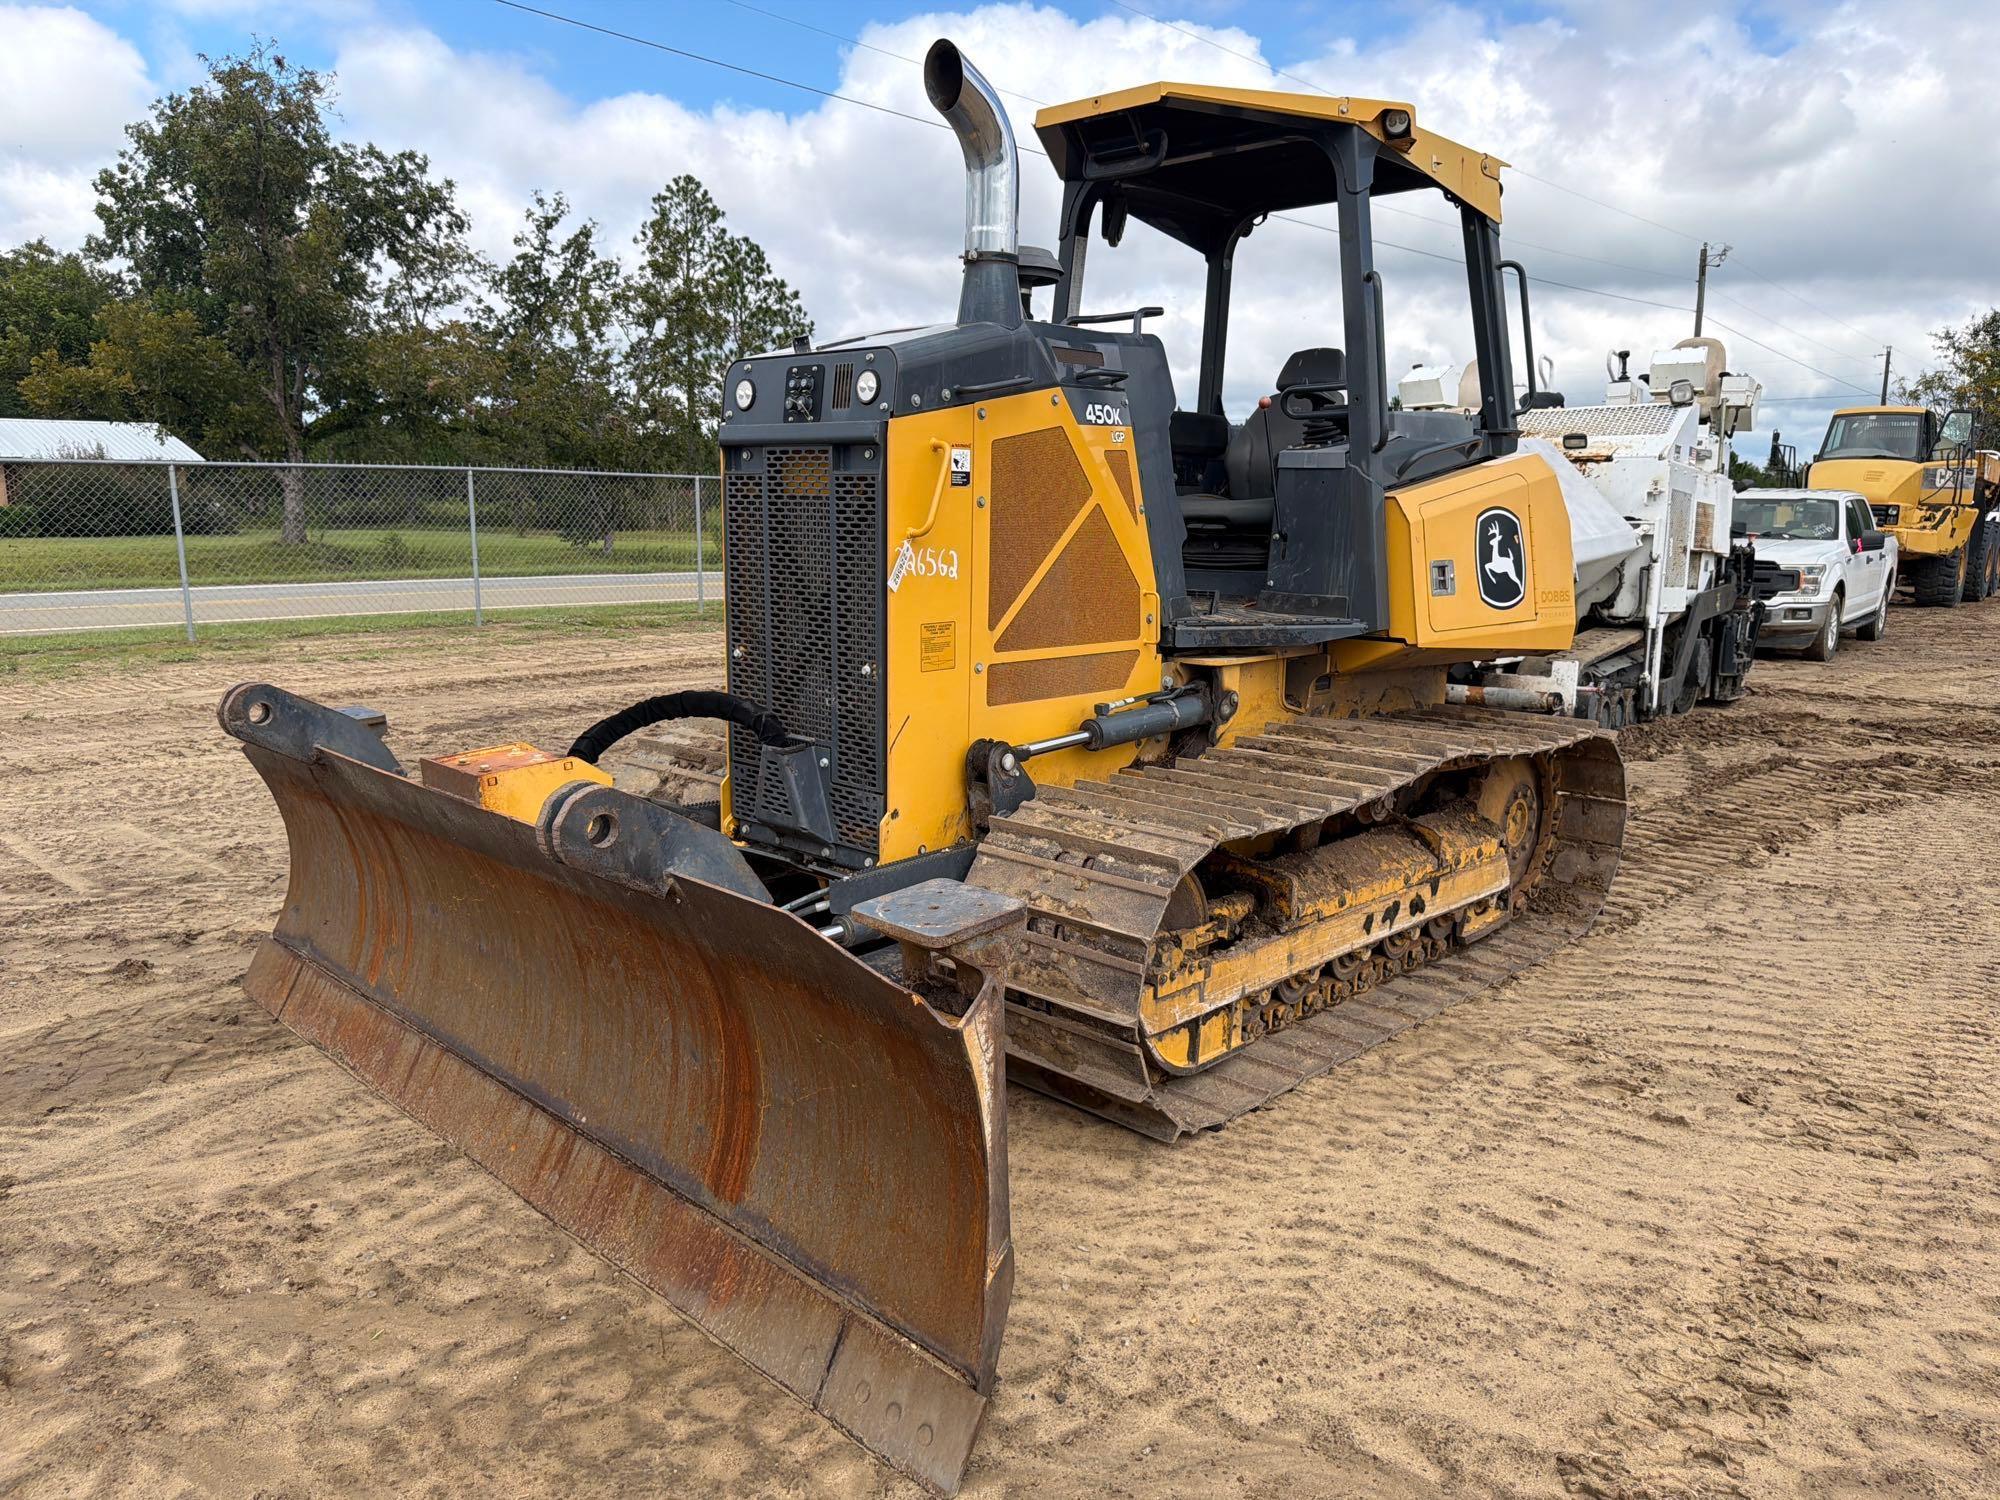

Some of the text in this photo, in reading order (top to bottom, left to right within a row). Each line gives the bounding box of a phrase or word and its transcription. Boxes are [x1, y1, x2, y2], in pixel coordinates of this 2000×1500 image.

[1085, 403, 1123, 425] 450K
[1111, 431, 1126, 443] LGP
[1541, 590, 1570, 603] DOBBS
